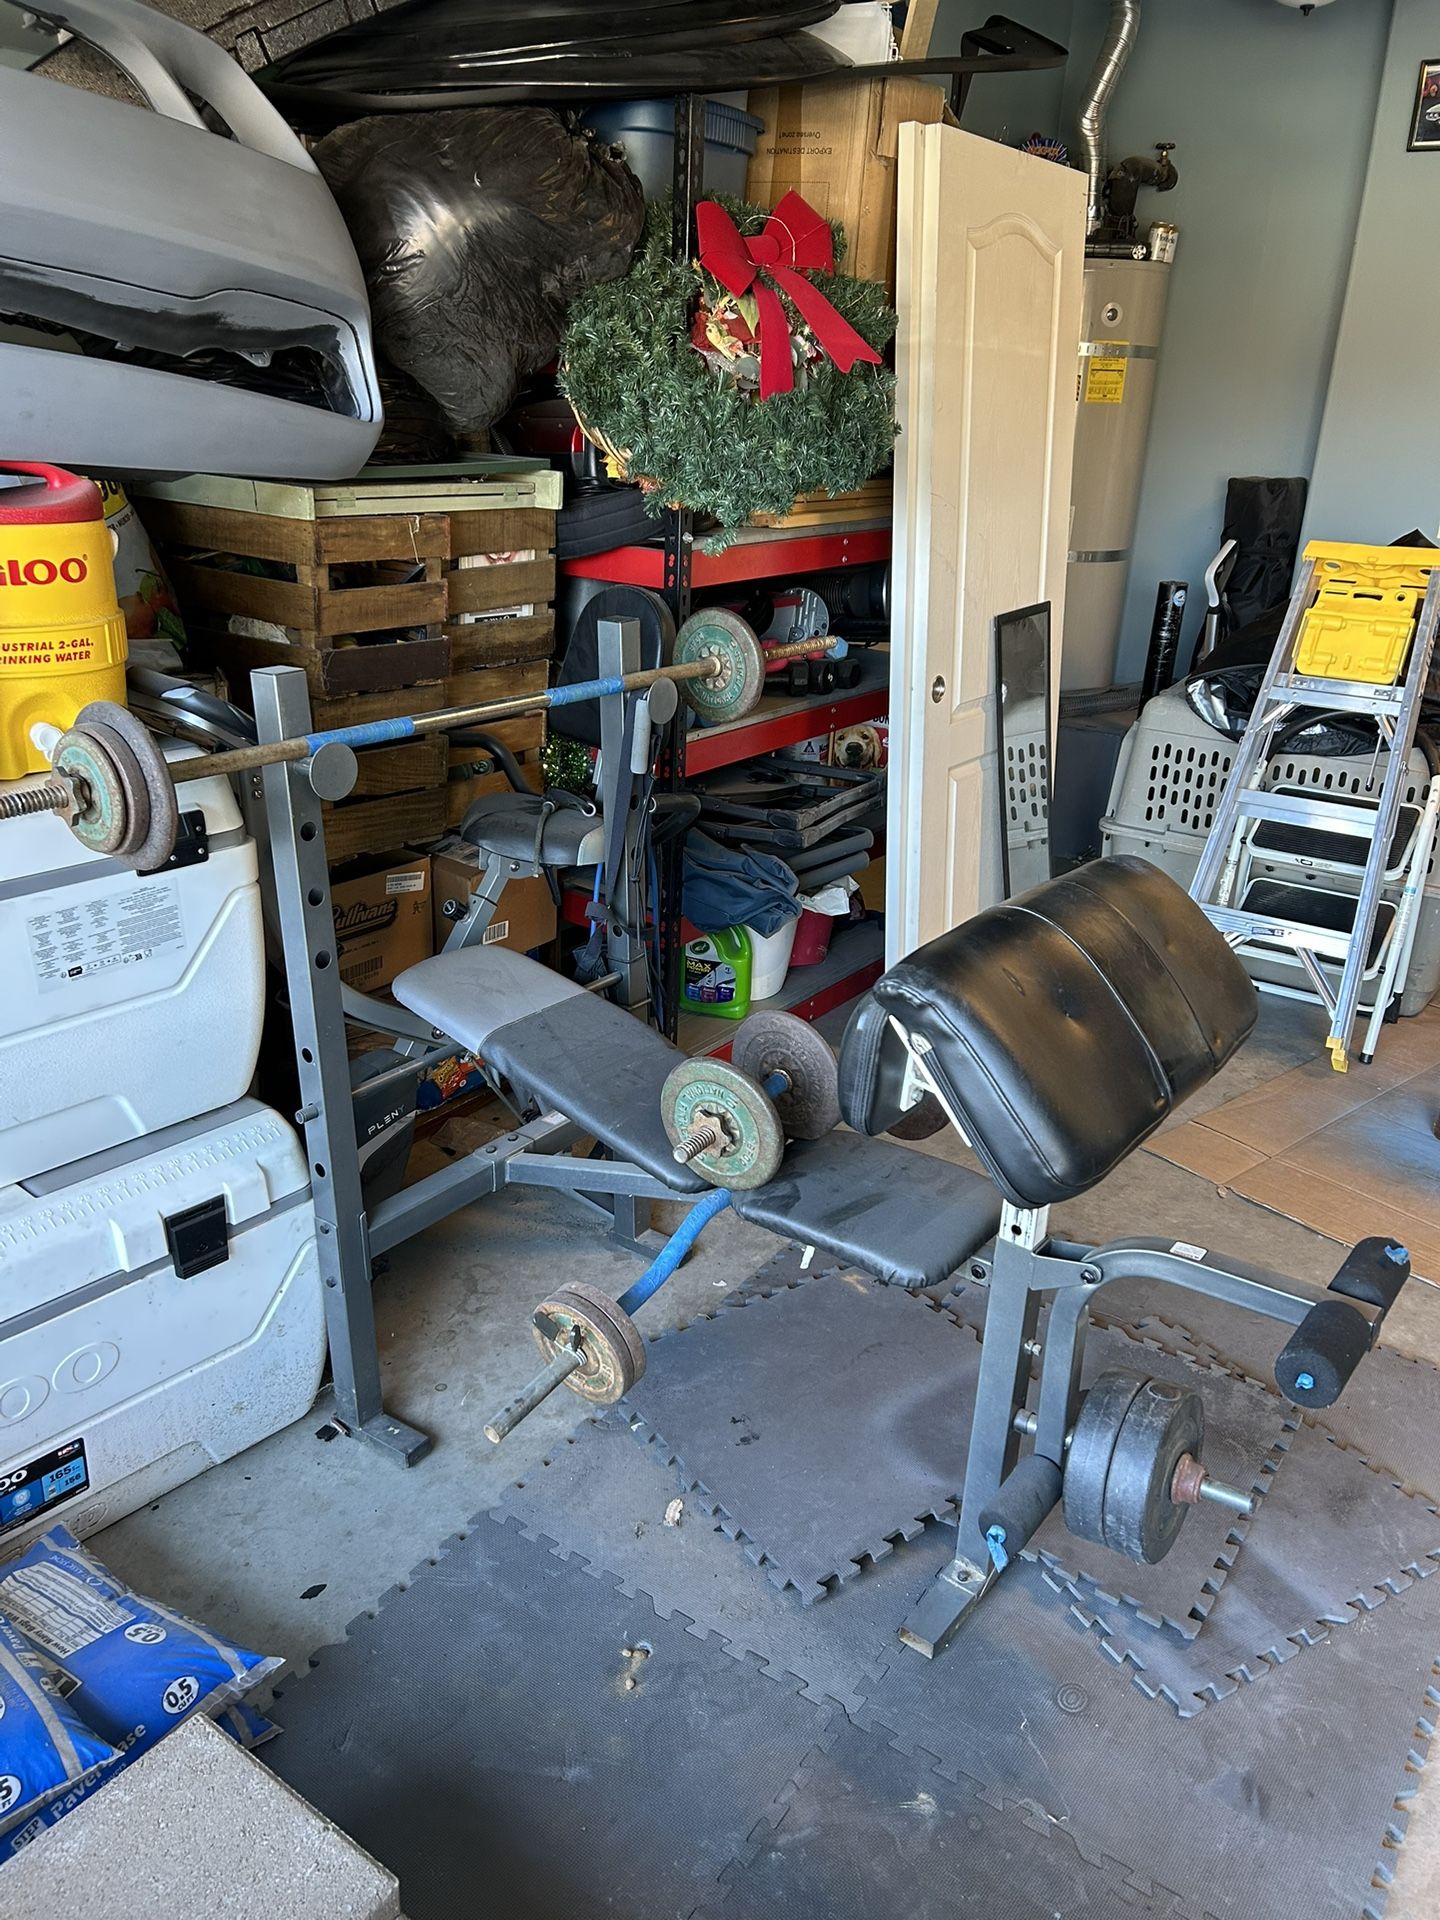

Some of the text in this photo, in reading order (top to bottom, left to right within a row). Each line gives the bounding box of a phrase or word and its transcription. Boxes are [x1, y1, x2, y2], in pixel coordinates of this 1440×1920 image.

[766, 147, 832, 155] EXPORT DESTINATION
[0, 557, 88, 586] LOO
[58, 638, 94, 650] 2-GAL.
[55, 650, 91, 662] WATER
[686, 959, 711, 970] MAX
[682, 1084, 725, 1101] NATIONAL
[367, 1104, 405, 1135] PLENY
[49, 1465, 72, 1483] 165
[33, 1630, 54, 1645] Many
[127, 1626, 161, 1643] 0.5
[51, 1641, 71, 1655] How
[165, 1678, 192, 1709] 0.5
[177, 1694, 194, 1711] CU FT
[50, 1769, 102, 1820] Paver
[14, 1819, 40, 1849] STEP
